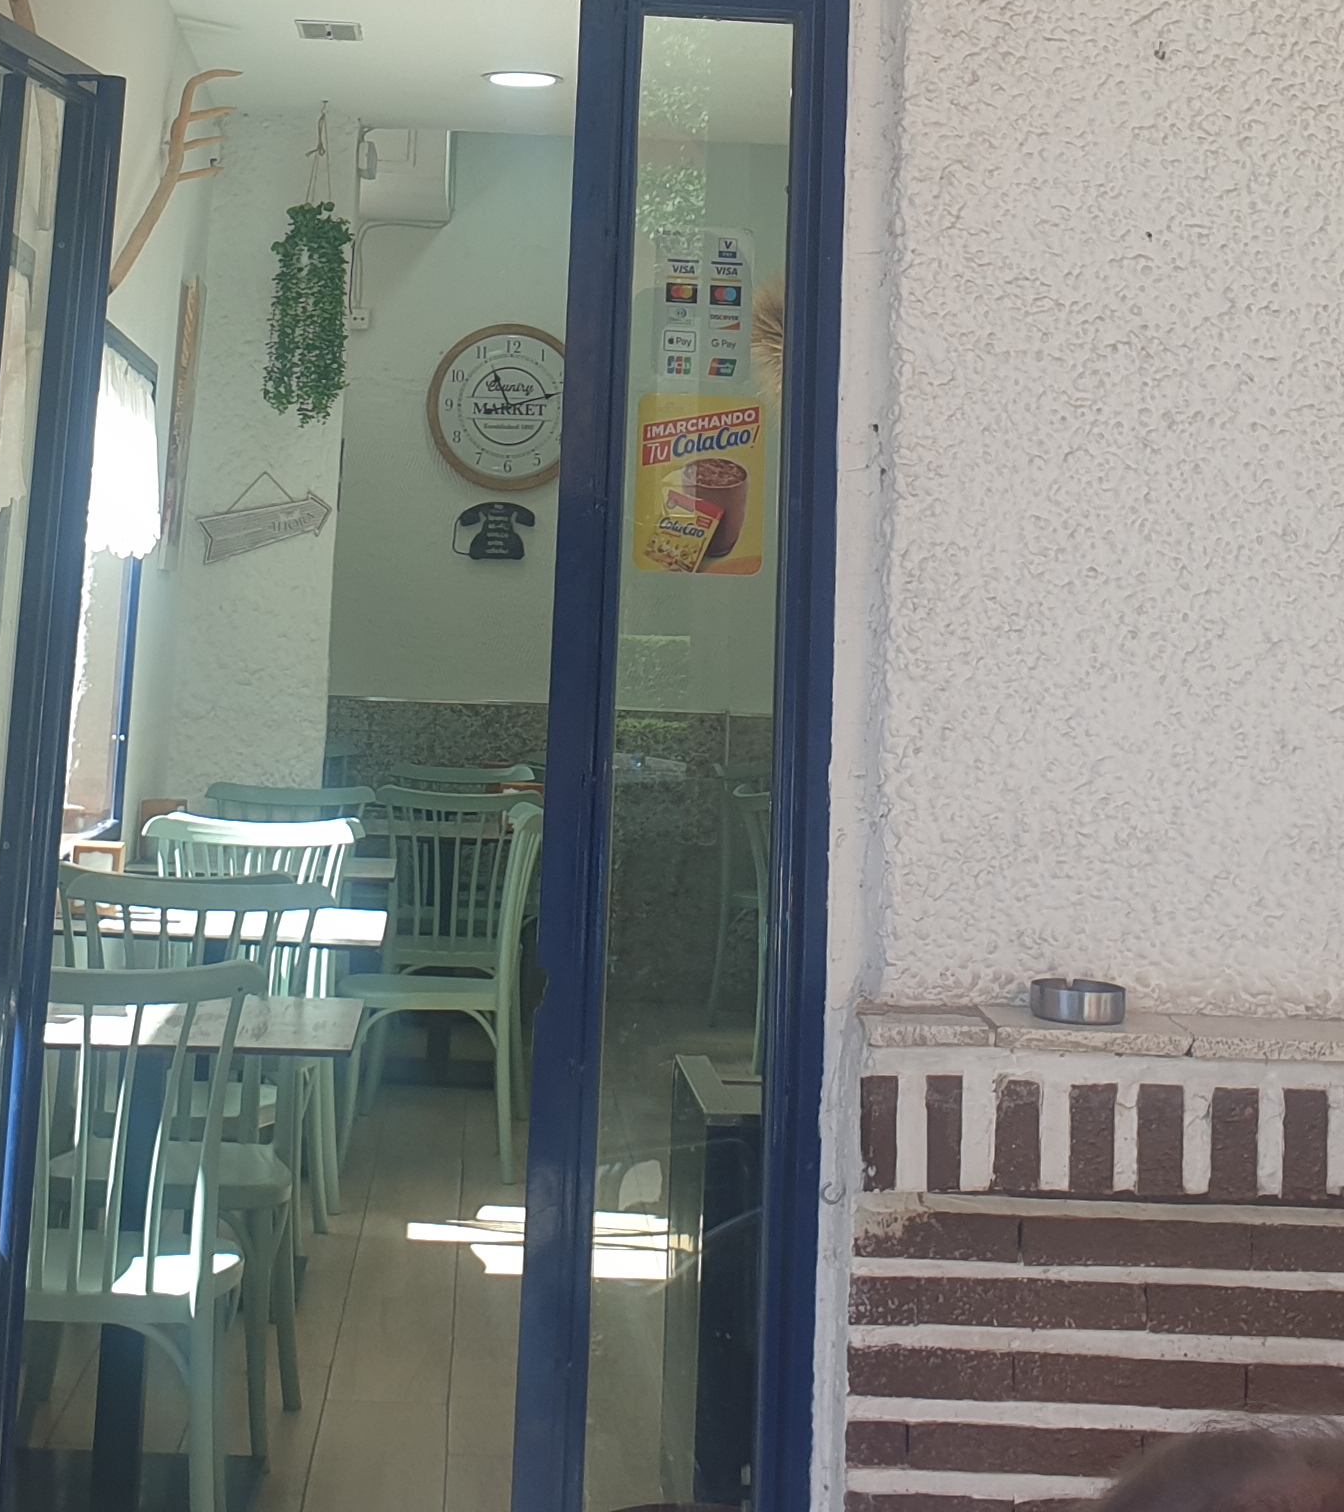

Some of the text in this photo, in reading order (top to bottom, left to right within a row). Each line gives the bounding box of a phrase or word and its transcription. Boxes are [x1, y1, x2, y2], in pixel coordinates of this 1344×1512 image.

[672, 264, 695, 275] VISA
[715, 267, 738, 276] VISA
[506, 340, 521, 354] 12
[675, 337, 692, 347] Pay
[721, 339, 737, 350] Pay
[476, 346, 487, 359] 11
[541, 349, 545, 362] 1
[451, 369, 465, 382] 10
[485, 380, 534, 396] Country
[445, 398, 453, 411] 9
[472, 402, 547, 416] MARKET
[452, 430, 461, 444] 8
[475, 452, 483, 465] 7
[533, 453, 541, 467] 5
[503, 460, 512, 473] 6
